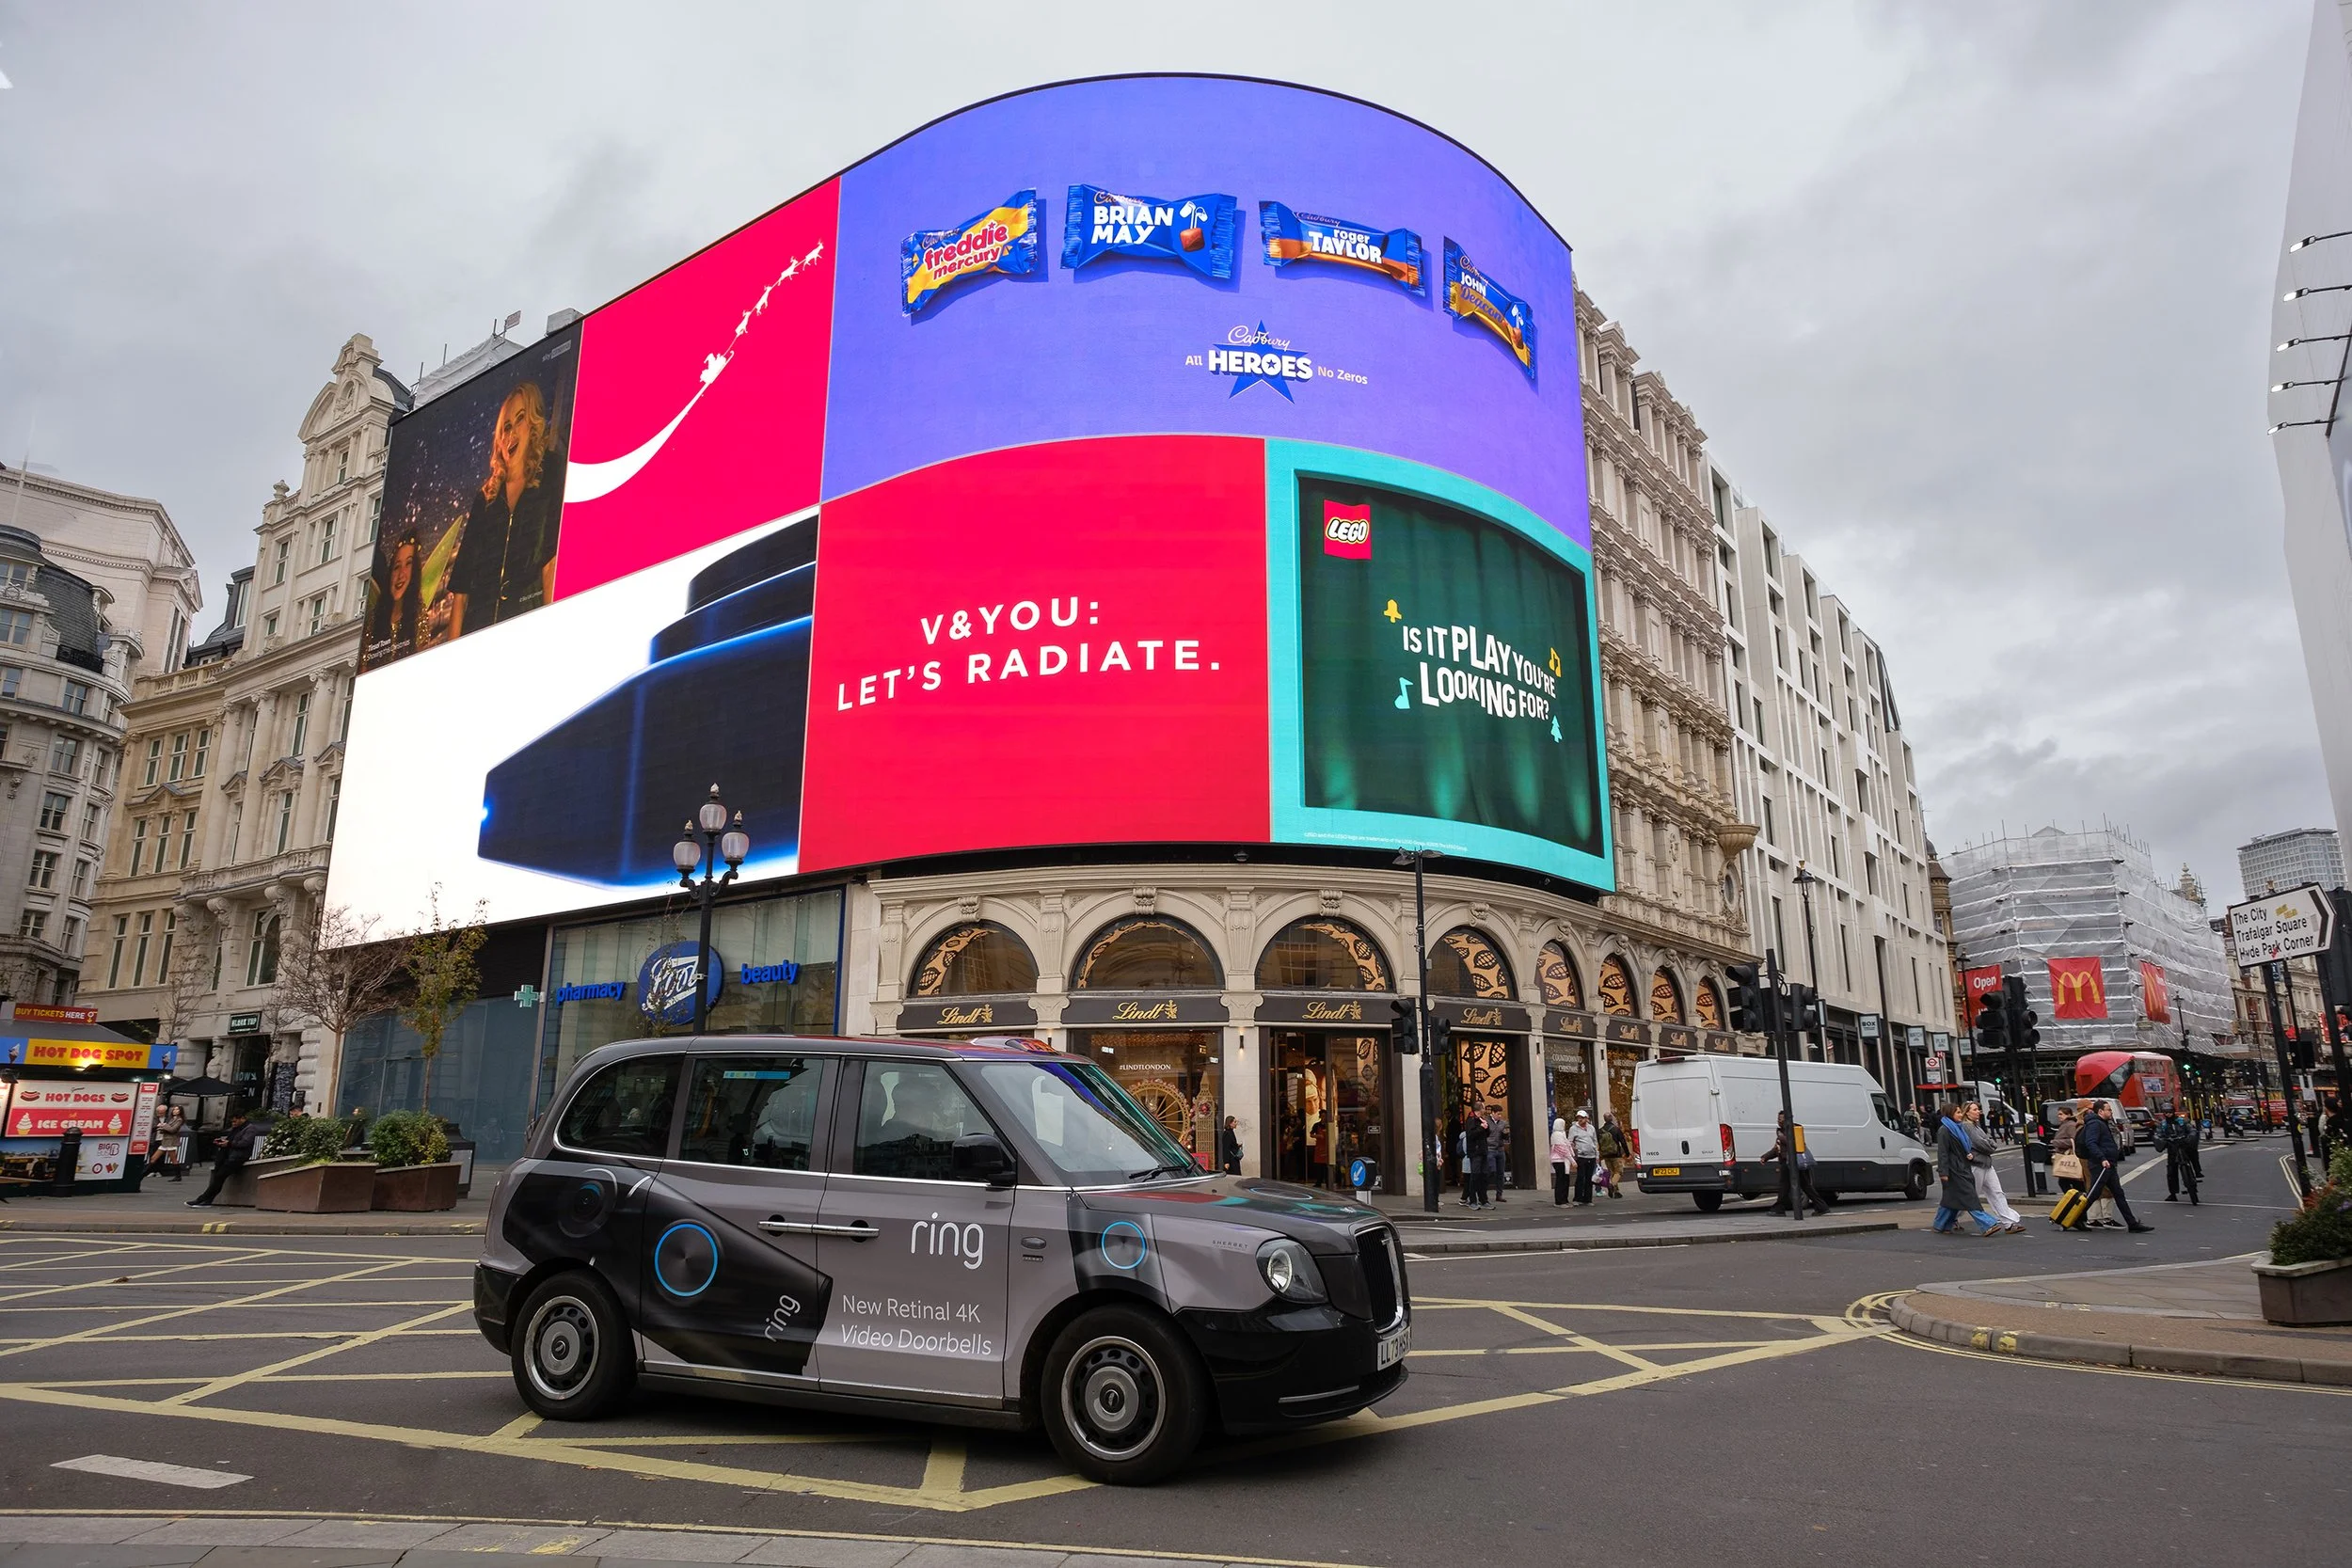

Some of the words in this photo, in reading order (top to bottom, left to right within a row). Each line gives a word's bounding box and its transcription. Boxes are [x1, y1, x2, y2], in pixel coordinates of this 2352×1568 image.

[1093, 205, 1174, 227] BRIAN
[924, 221, 1009, 271] freddie
[1091, 225, 1156, 245] MAY
[1308, 230, 1383, 264] TAYLOR
[1333, 229, 1371, 245] roger
[932, 245, 1002, 280] mercury
[1461, 271, 1486, 297] JOHN
[1460, 285, 1504, 325] Deacon
[1228, 325, 1291, 352] Cadbury
[1184, 355, 1203, 366] All
[1208, 349, 1313, 381] HEROES
[1317, 366, 1334, 378] No
[1337, 369, 1369, 385] Zeros
[1326, 518, 1369, 543] LEGO
[920, 596, 1099, 645] V&YOU:
[1402, 626, 1422, 654] IS
[1426, 625, 1449, 659] IT
[1451, 625, 1512, 676] PLAY
[1512, 650, 1557, 699] YOU'RE
[837, 660, 942, 712] LET'S
[967, 640, 1221, 684] RADIATE.
[1419, 660, 1517, 719] LOOKING
[1518, 691, 1550, 721] FOR?
[2233, 912, 2249, 926] The
[2250, 908, 2267, 922] City
[2236, 925, 2273, 942] Trafalgar
[2275, 917, 2308, 935] Square
[2262, 940, 2282, 956] Park
[2283, 934, 2314, 951] Corner
[740, 958, 801, 986] beauty
[1973, 975, 1997, 990] Open
[556, 980, 627, 1006] pharmacy
[33, 1008, 65, 1018] TICKETS
[65, 1011, 86, 1020] HERE
[936, 1006, 982, 1025] Lindt
[1112, 1001, 1166, 1020] Lindt
[1302, 1001, 1350, 1021] Lindt
[1460, 1007, 1493, 1025] Lindt
[33, 1045, 68, 1058] HOT
[70, 1048, 103, 1060] DOG
[105, 1050, 144, 1062] SPOT
[45, 1093, 72, 1102] HOT
[73, 1094, 106, 1102] DOGS
[37, 1119, 58, 1129] ICE
[60, 1119, 104, 1129] CREAM
[911, 1212, 984, 1270] ring
[764, 1294, 801, 1343] ring
[842, 1294, 882, 1316] New
[887, 1298, 949, 1321] Retinal
[956, 1304, 980, 1323] 4K
[841, 1324, 893, 1348] Video
[898, 1328, 993, 1355] Doorbells
